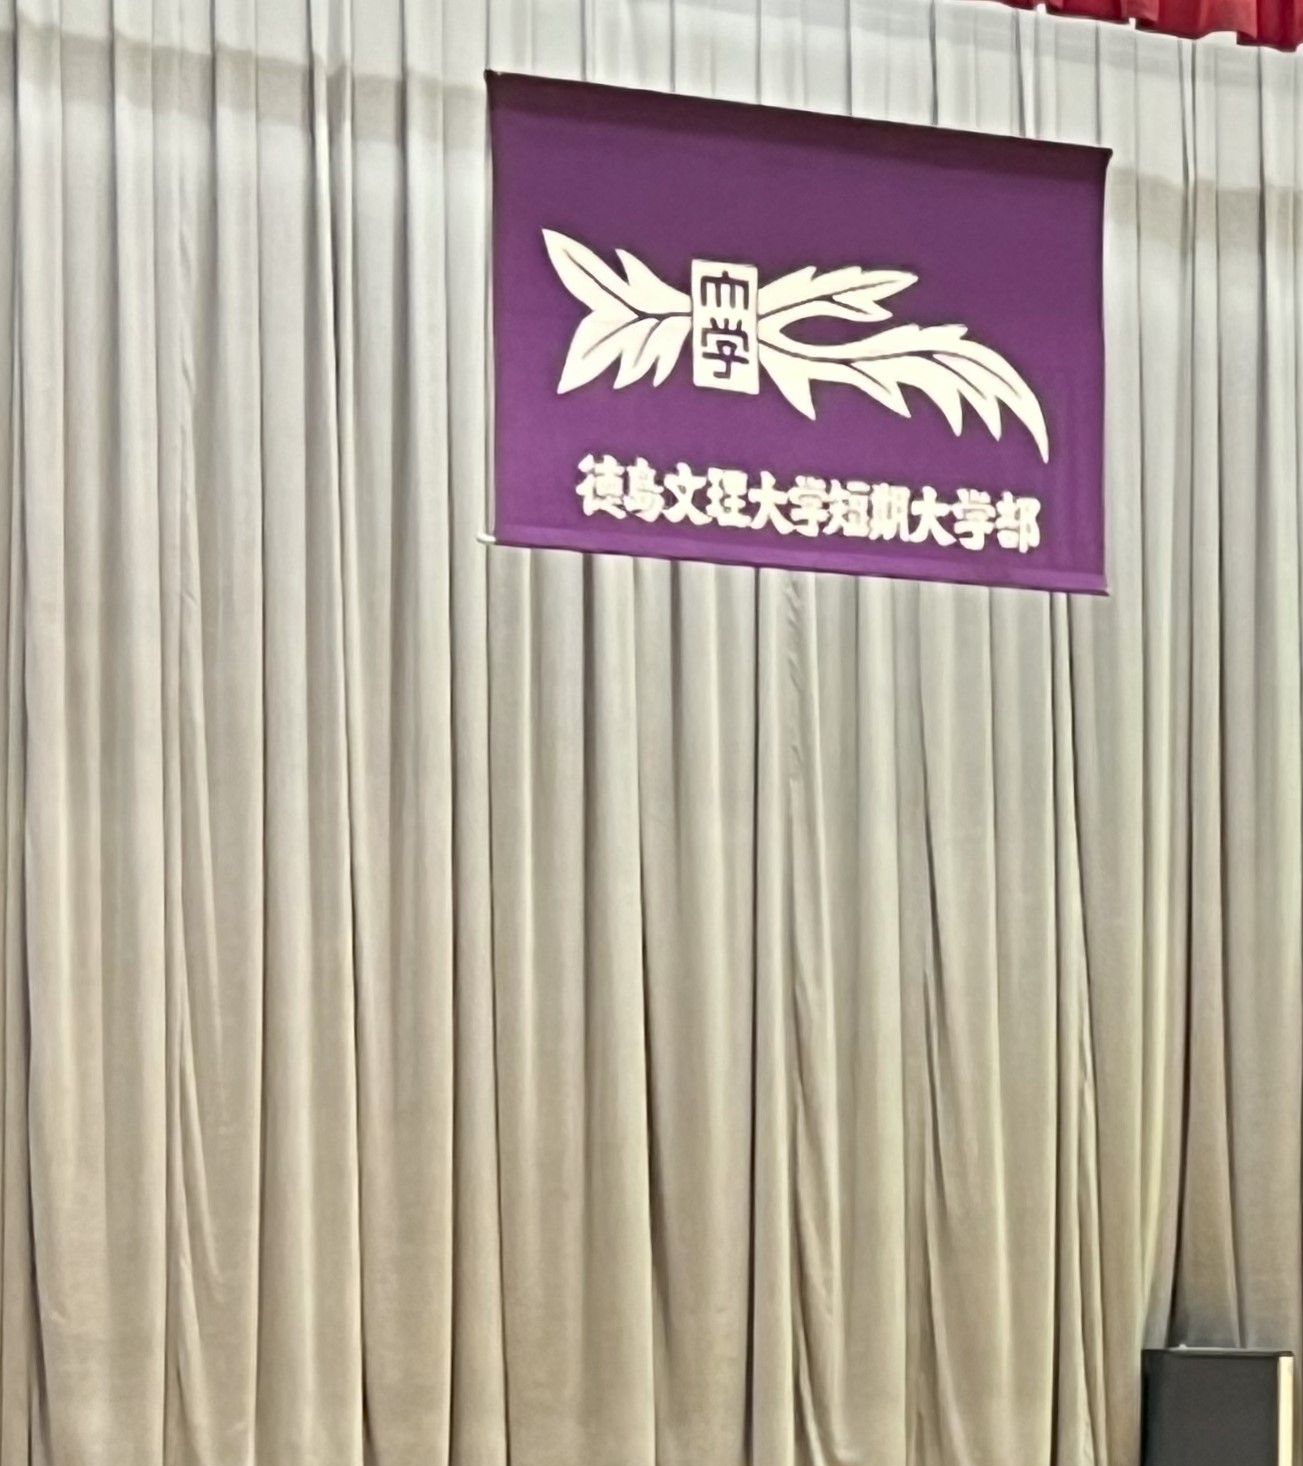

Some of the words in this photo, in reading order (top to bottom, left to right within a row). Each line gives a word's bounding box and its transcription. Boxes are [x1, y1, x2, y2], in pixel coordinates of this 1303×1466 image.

[576, 454, 1041, 554] 徳島文理大学短期大学部
